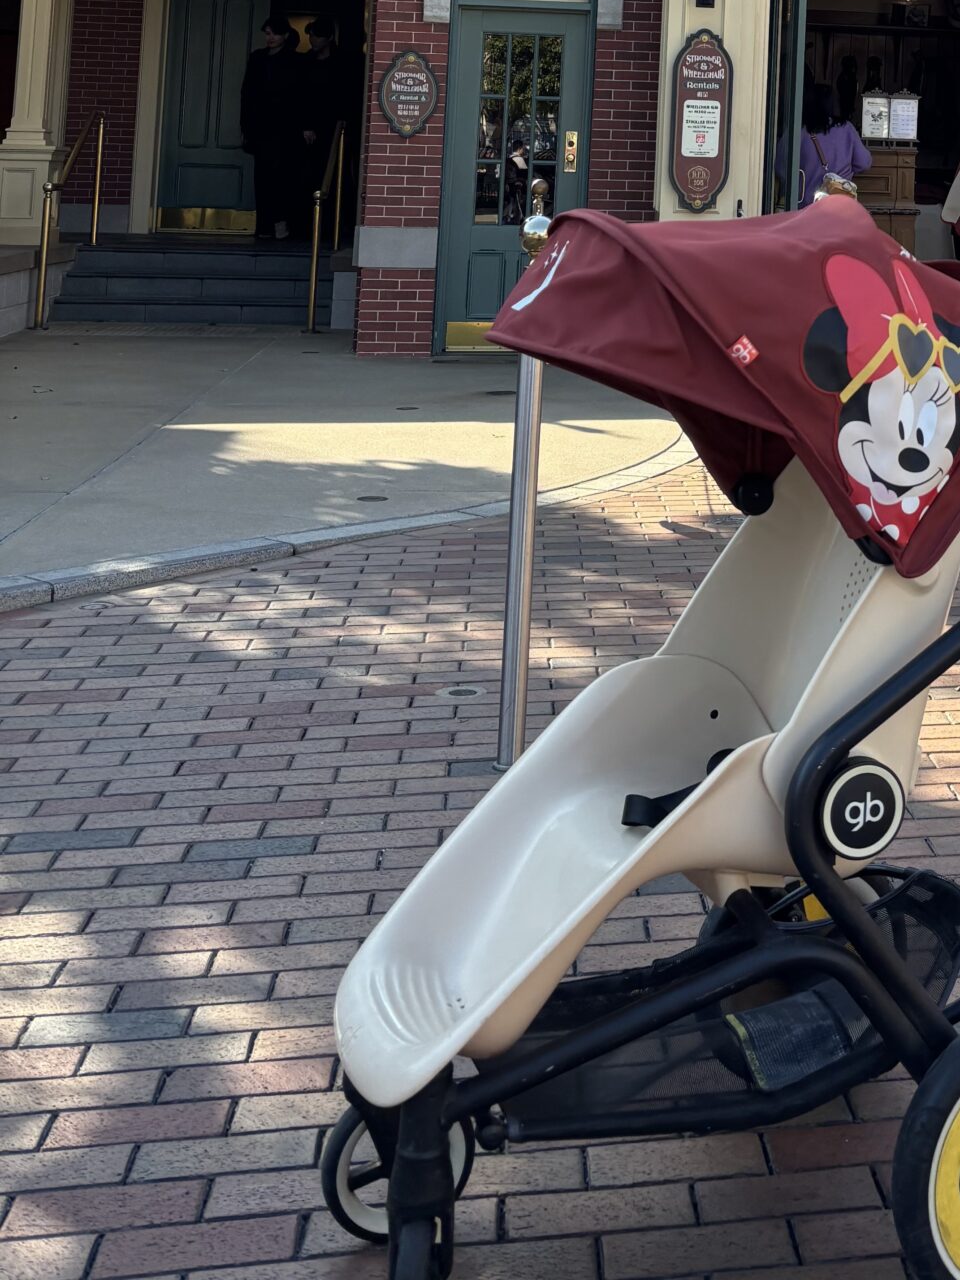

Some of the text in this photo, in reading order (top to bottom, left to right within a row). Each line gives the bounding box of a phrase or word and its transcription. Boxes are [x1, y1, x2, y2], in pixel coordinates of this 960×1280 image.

[683, 66, 725, 80] WHEELCHAIR
[686, 81, 720, 89] Rentals
[844, 791, 885, 832] gb
